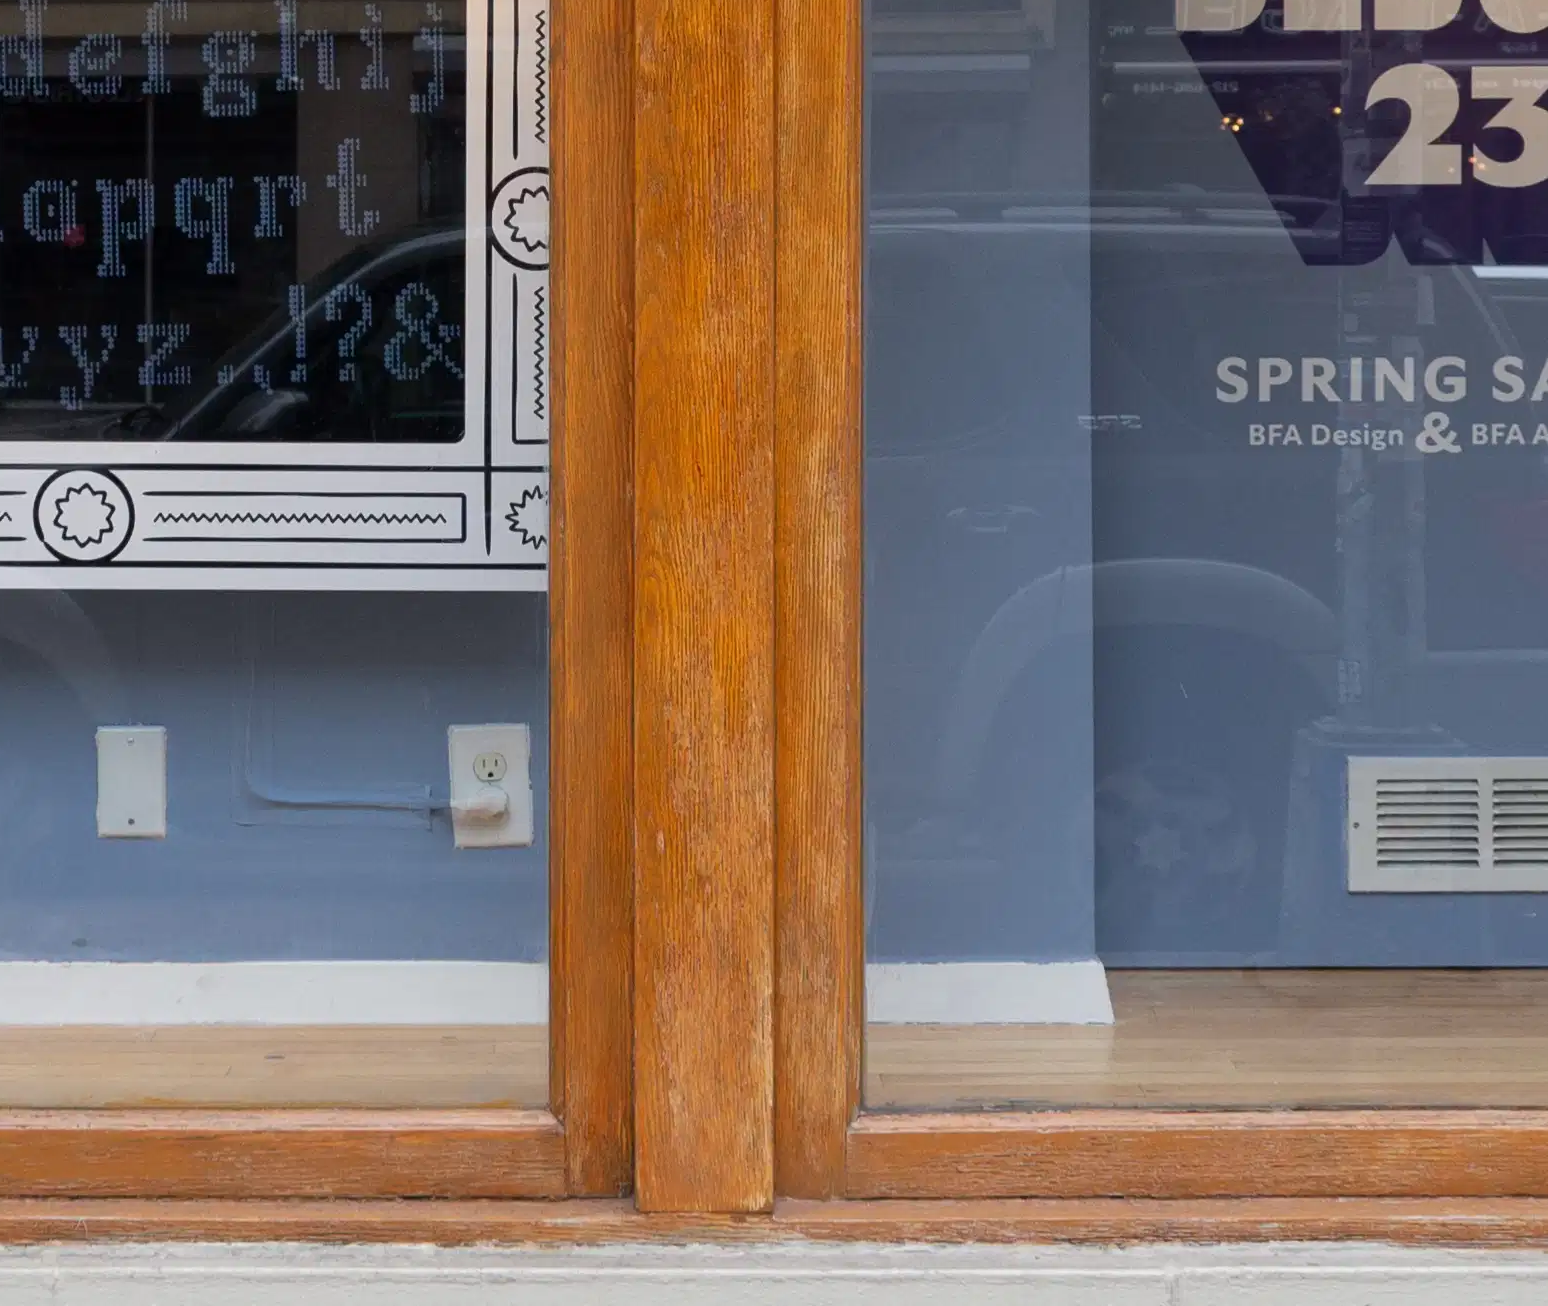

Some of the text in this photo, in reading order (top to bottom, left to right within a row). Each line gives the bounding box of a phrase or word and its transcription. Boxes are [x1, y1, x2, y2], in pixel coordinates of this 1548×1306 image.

[1215, 355, 1468, 403] SPRING
[1249, 423, 1304, 446] BFA
[1311, 422, 1404, 451] Design
[1415, 410, 1462, 454] &
[1471, 423, 1525, 446] BFA
